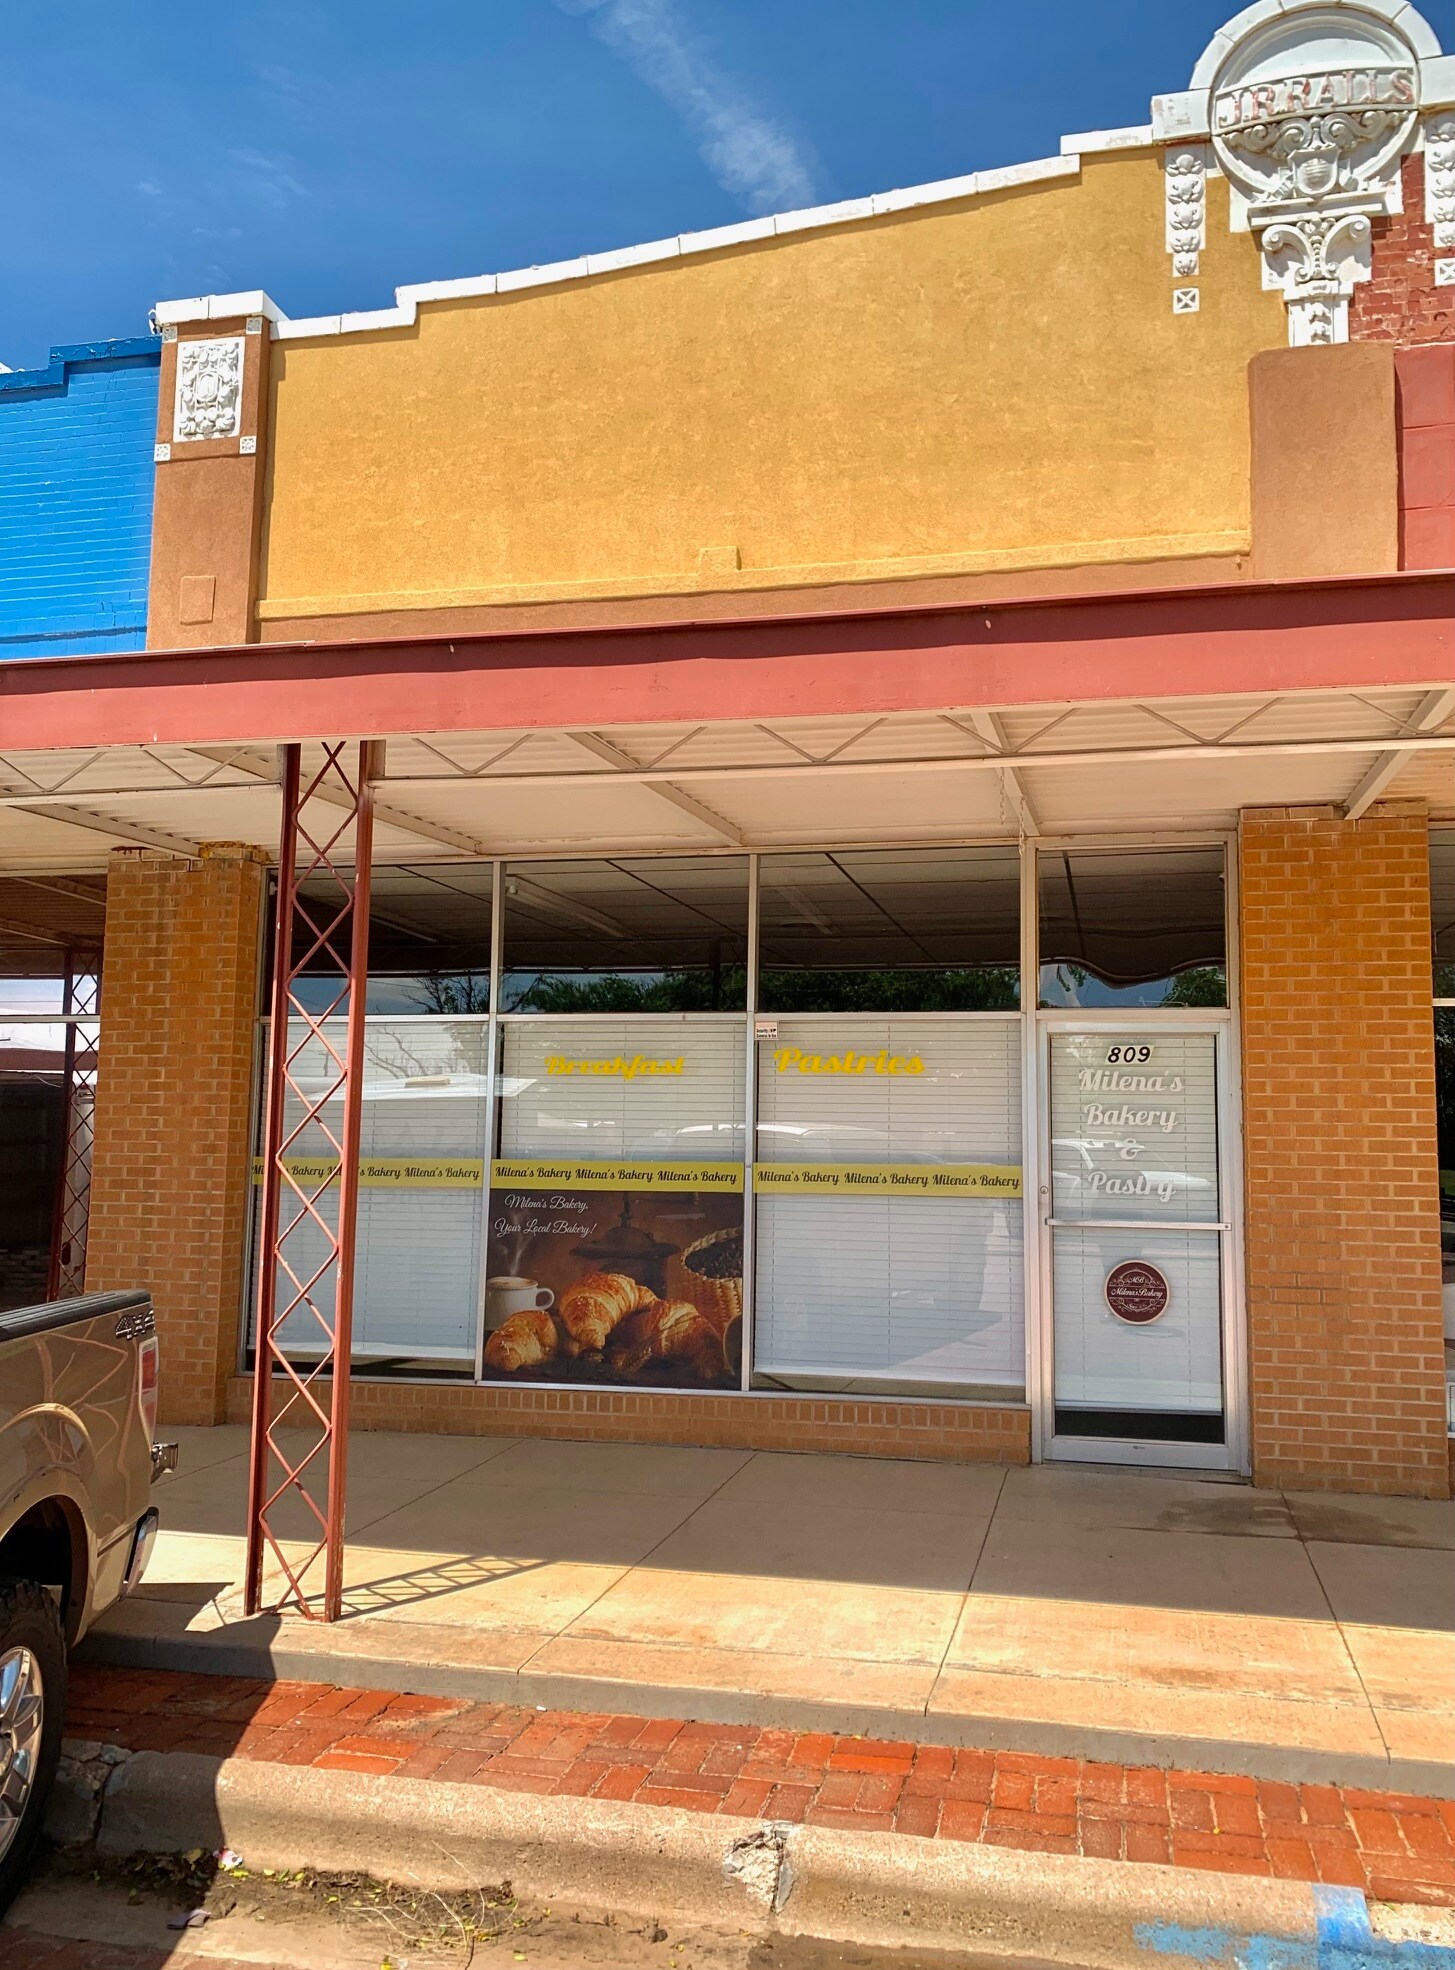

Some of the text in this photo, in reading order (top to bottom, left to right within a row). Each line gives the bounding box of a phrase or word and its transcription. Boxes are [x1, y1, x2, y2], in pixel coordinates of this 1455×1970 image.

[773, 1047, 926, 1074] Pastries
[1107, 1046, 1151, 1063] 809
[544, 1055, 685, 1080] Breakfast
[1078, 1067, 1185, 1092] Milena's
[1084, 1103, 1179, 1133] Bakery
[1120, 1138, 1142, 1160] &
[291, 1165, 325, 1178] Bakery
[367, 1167, 401, 1179] Bakery
[404, 1166, 443, 1178] Milena's
[445, 1168, 480, 1180] Bakery
[495, 1166, 737, 1184] Milena's Bakery Milena's Bakery Milena's Bakery
[757, 1170, 1020, 1190] Milena's Bakery Milena's Bakery Milena's Bakery
[504, 1194, 547, 1209] Milena's
[494, 1218, 597, 1238] Your Local Bakery!
